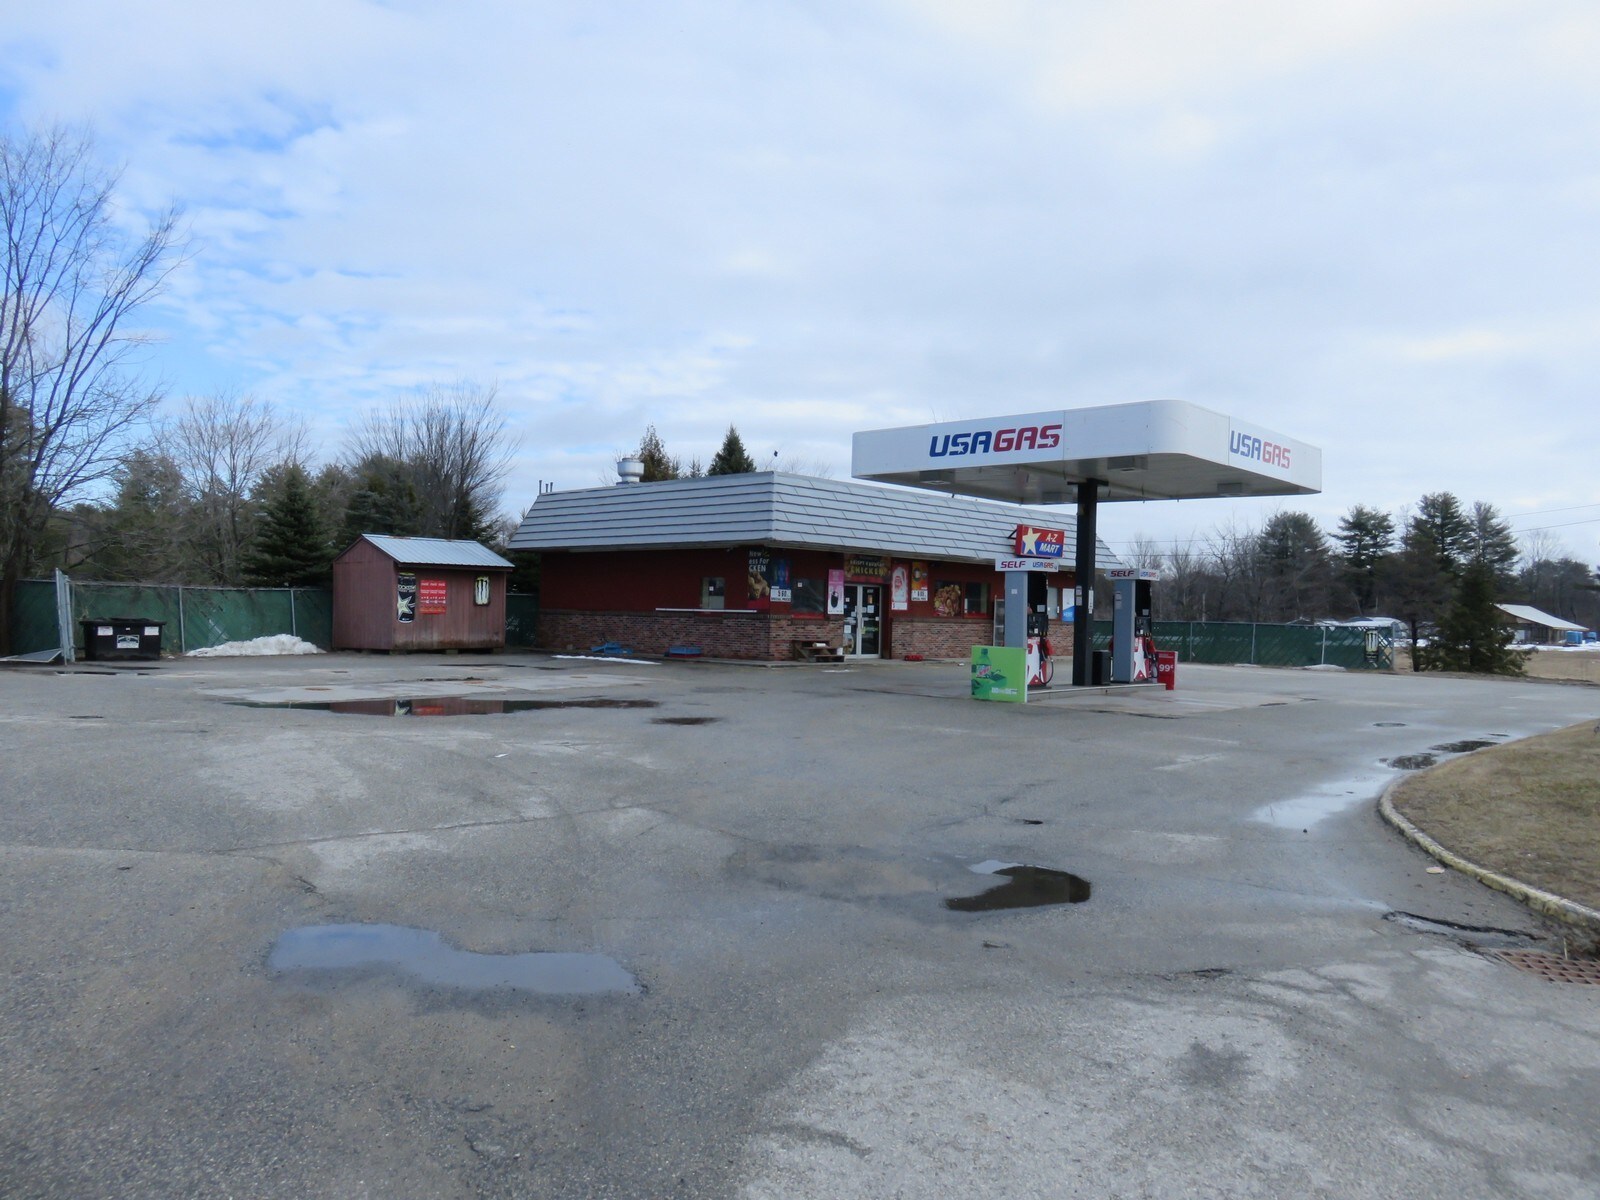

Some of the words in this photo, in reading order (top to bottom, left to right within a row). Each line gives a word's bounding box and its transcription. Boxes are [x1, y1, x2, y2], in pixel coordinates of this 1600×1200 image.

[1045, 532, 1059, 543] A-Z
[1039, 542, 1060, 554] MART
[1000, 560, 1026, 569] SELF
[1110, 570, 1135, 578] SELF
